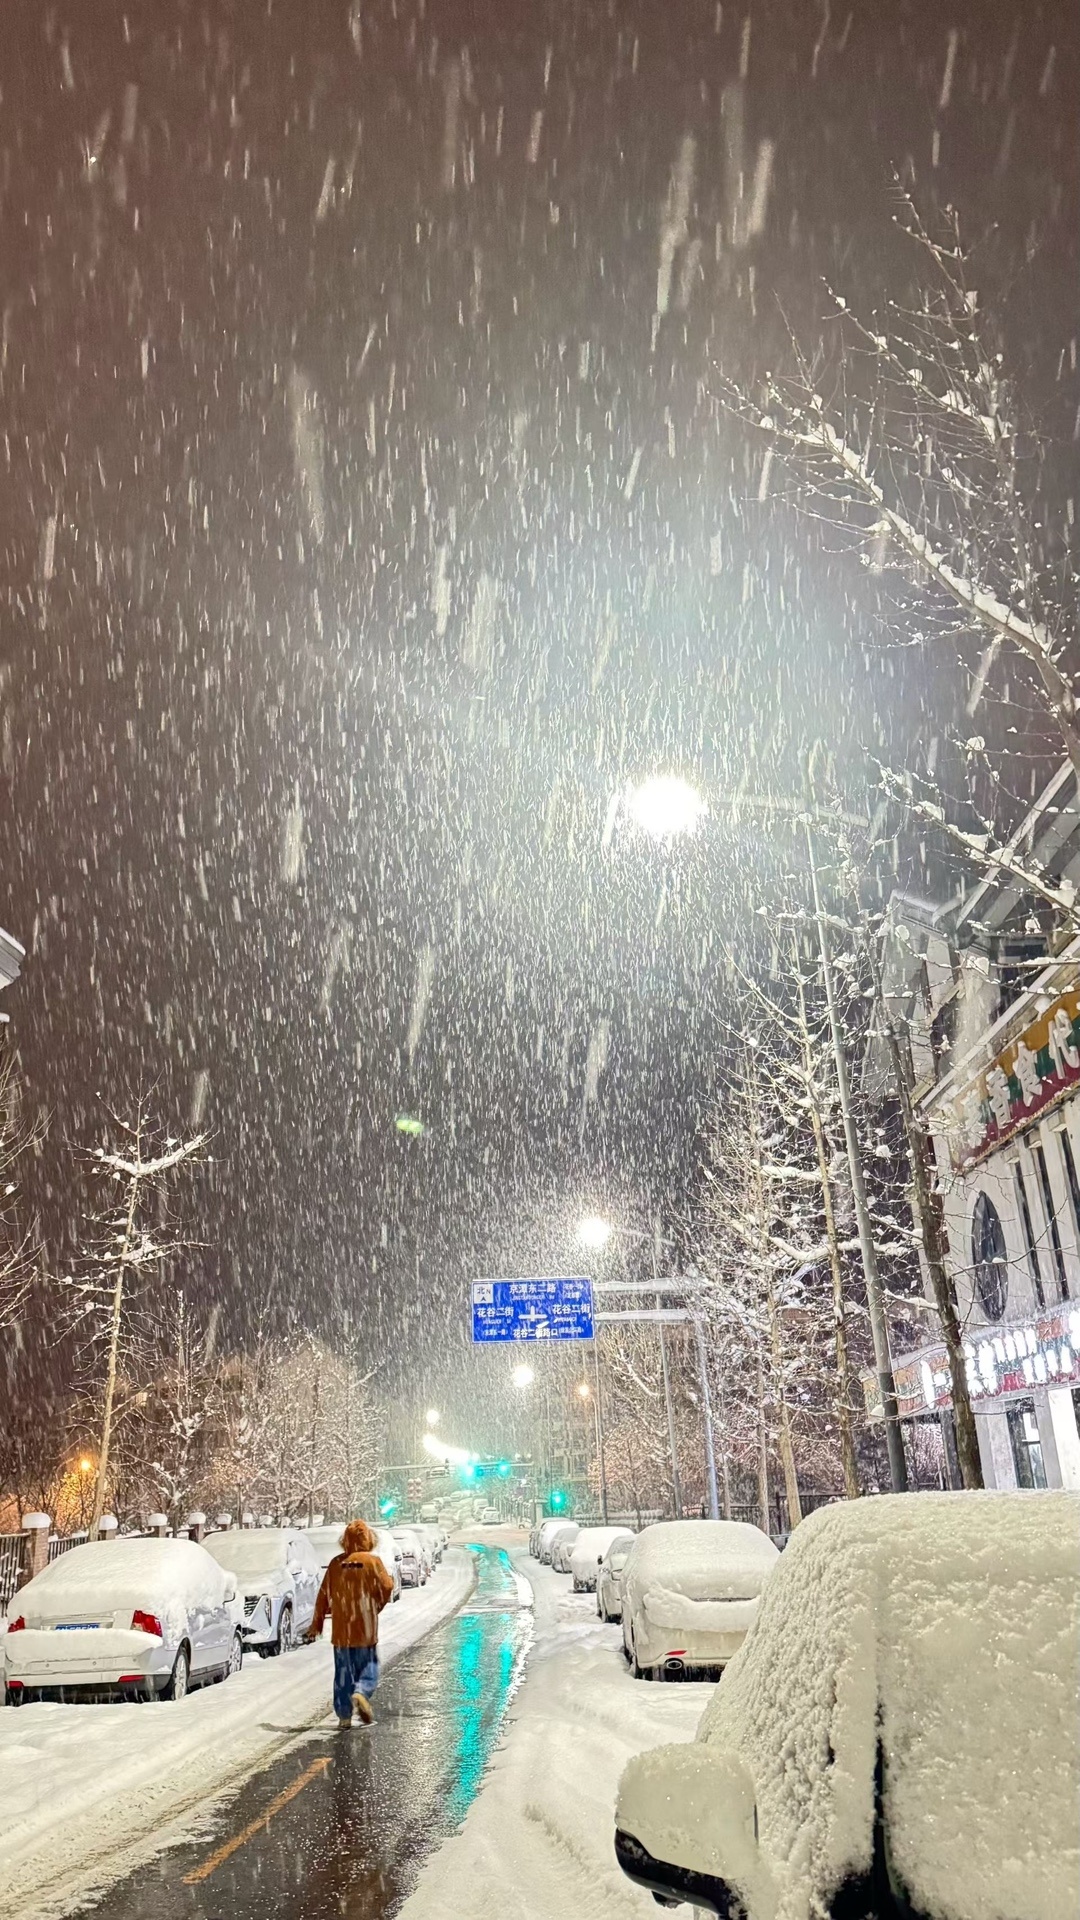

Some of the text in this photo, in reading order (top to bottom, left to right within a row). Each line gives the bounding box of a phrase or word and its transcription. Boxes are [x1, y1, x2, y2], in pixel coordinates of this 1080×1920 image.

[477, 1286, 485, 1295] 北
[477, 1306, 514, 1318] 花谷二街
[553, 1303, 590, 1315] 花谷二街
